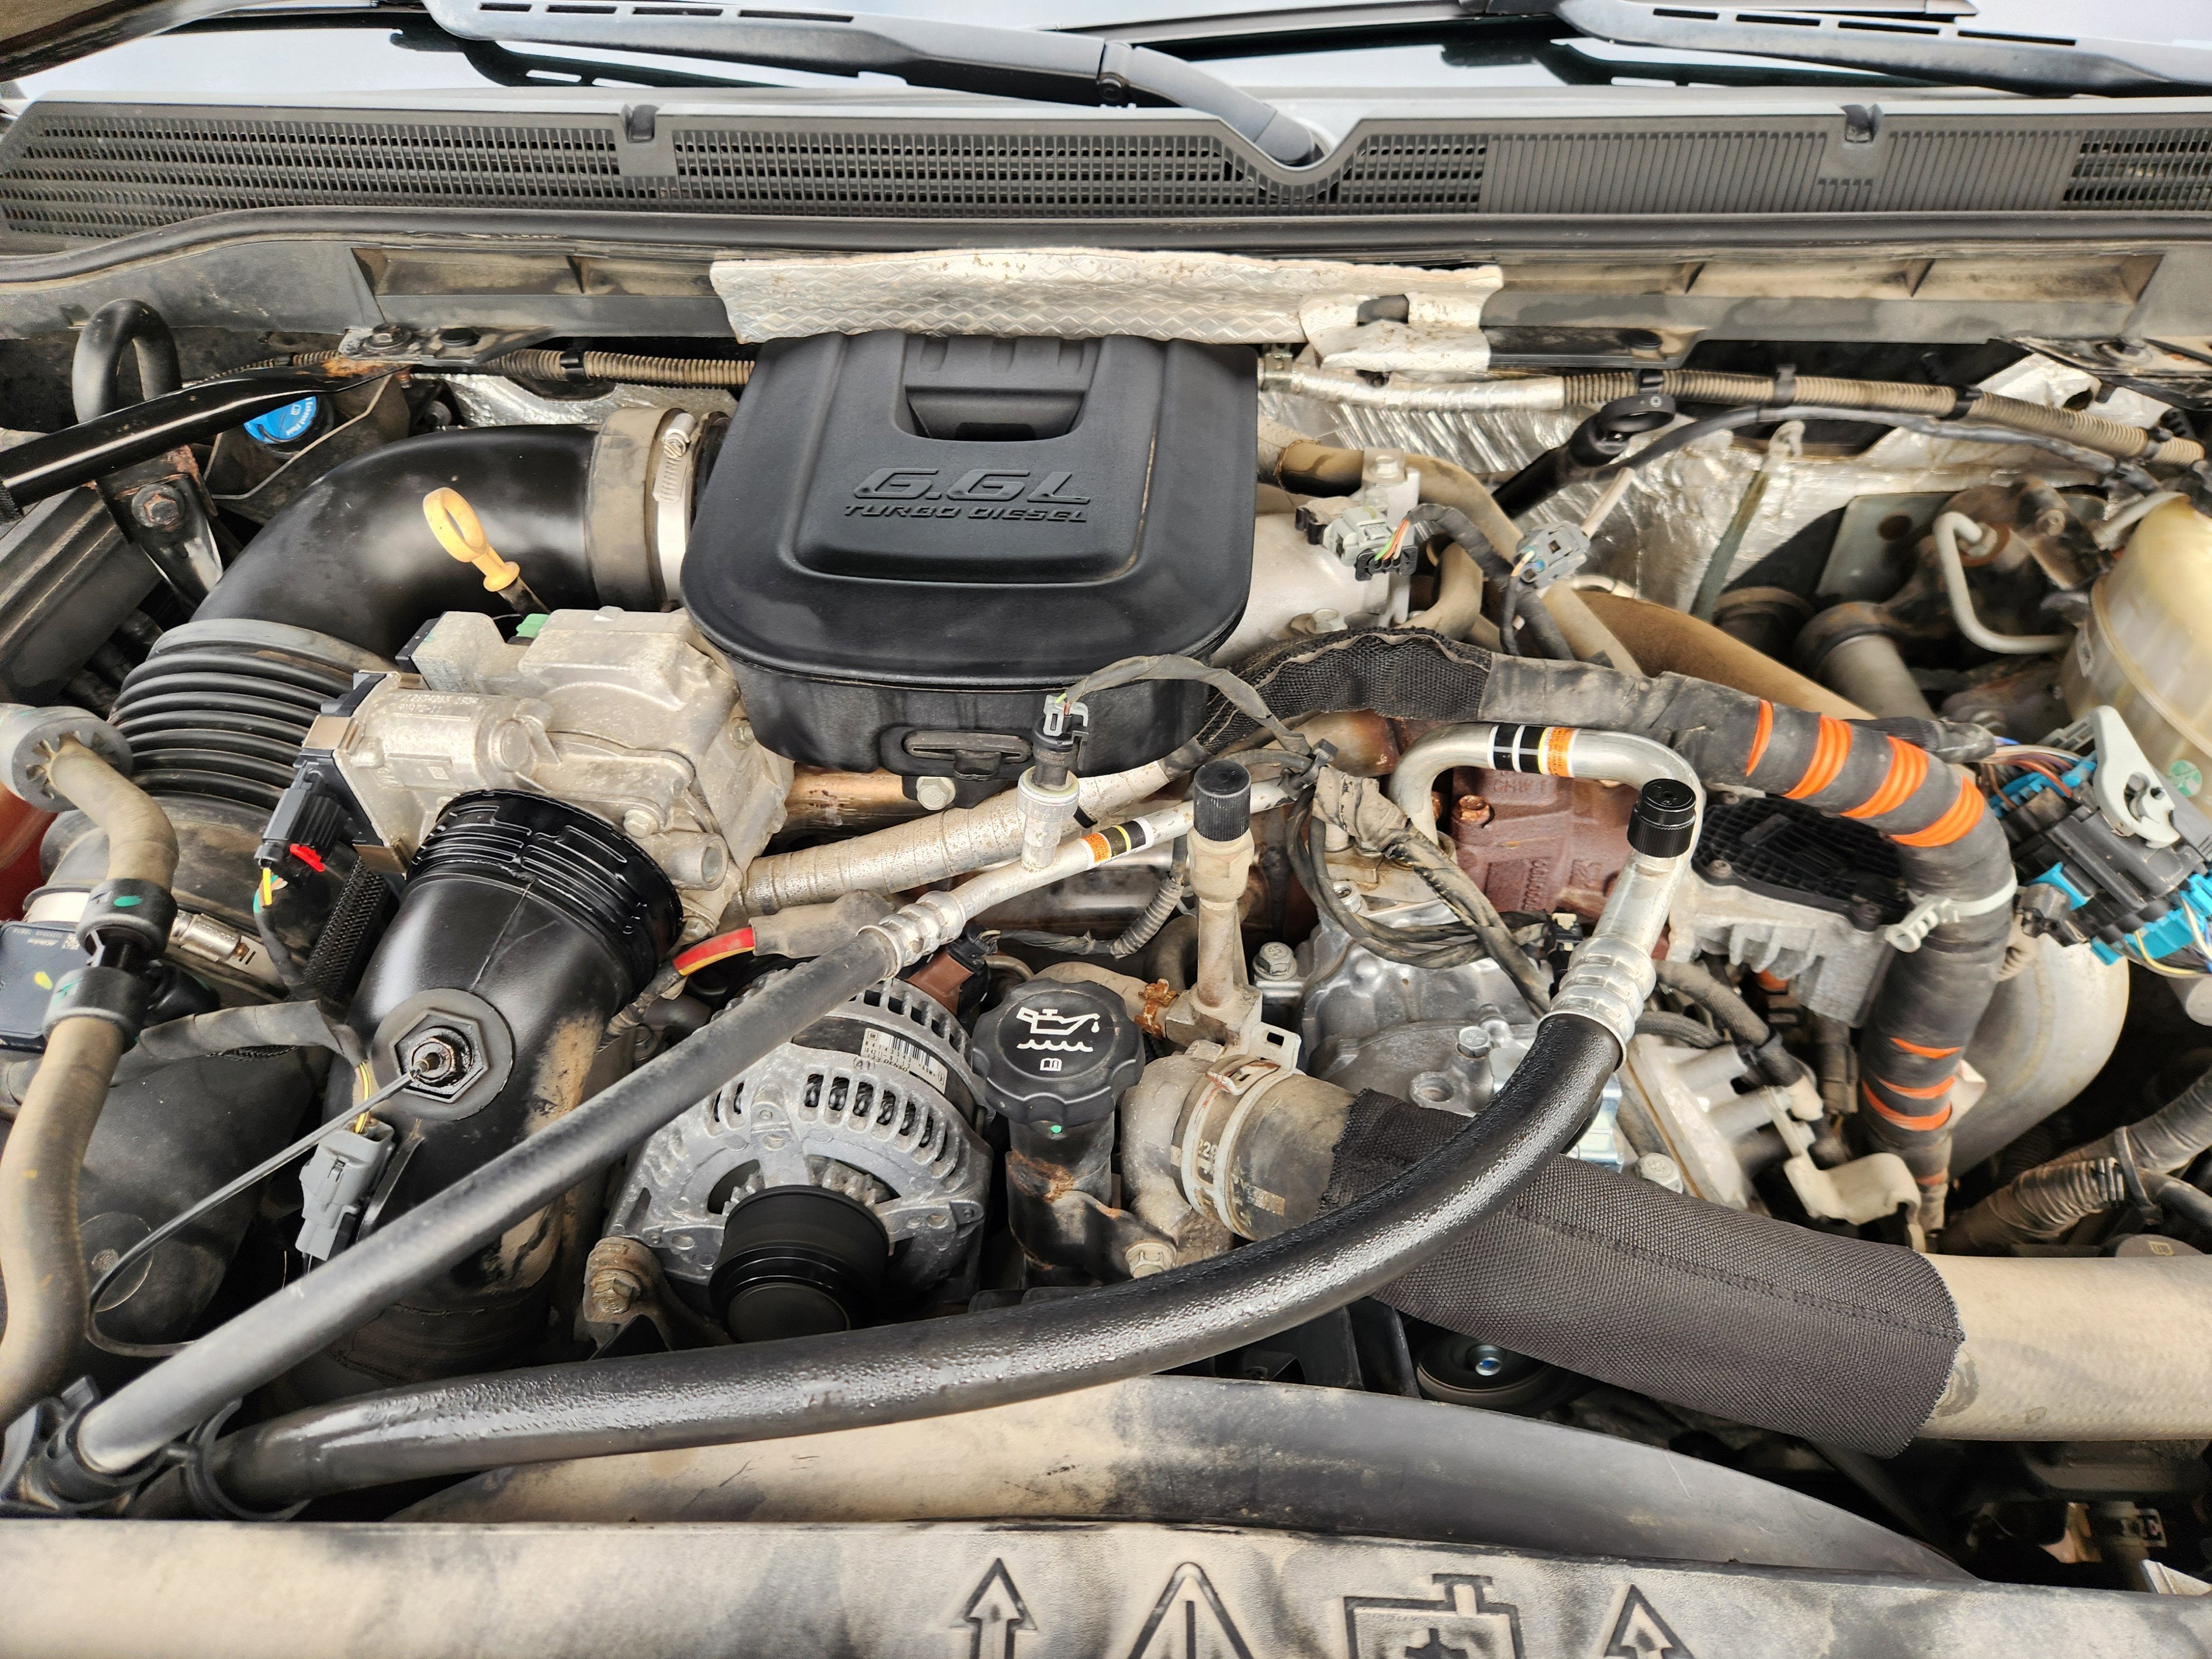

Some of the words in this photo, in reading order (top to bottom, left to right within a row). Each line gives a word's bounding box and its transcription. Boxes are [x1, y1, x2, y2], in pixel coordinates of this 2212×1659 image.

[854, 468, 1090, 504] 6.6L
[844, 504, 959, 518] TURBO
[968, 506, 1088, 523] DIESEL
[884, 1059, 909, 1072] DENSO
